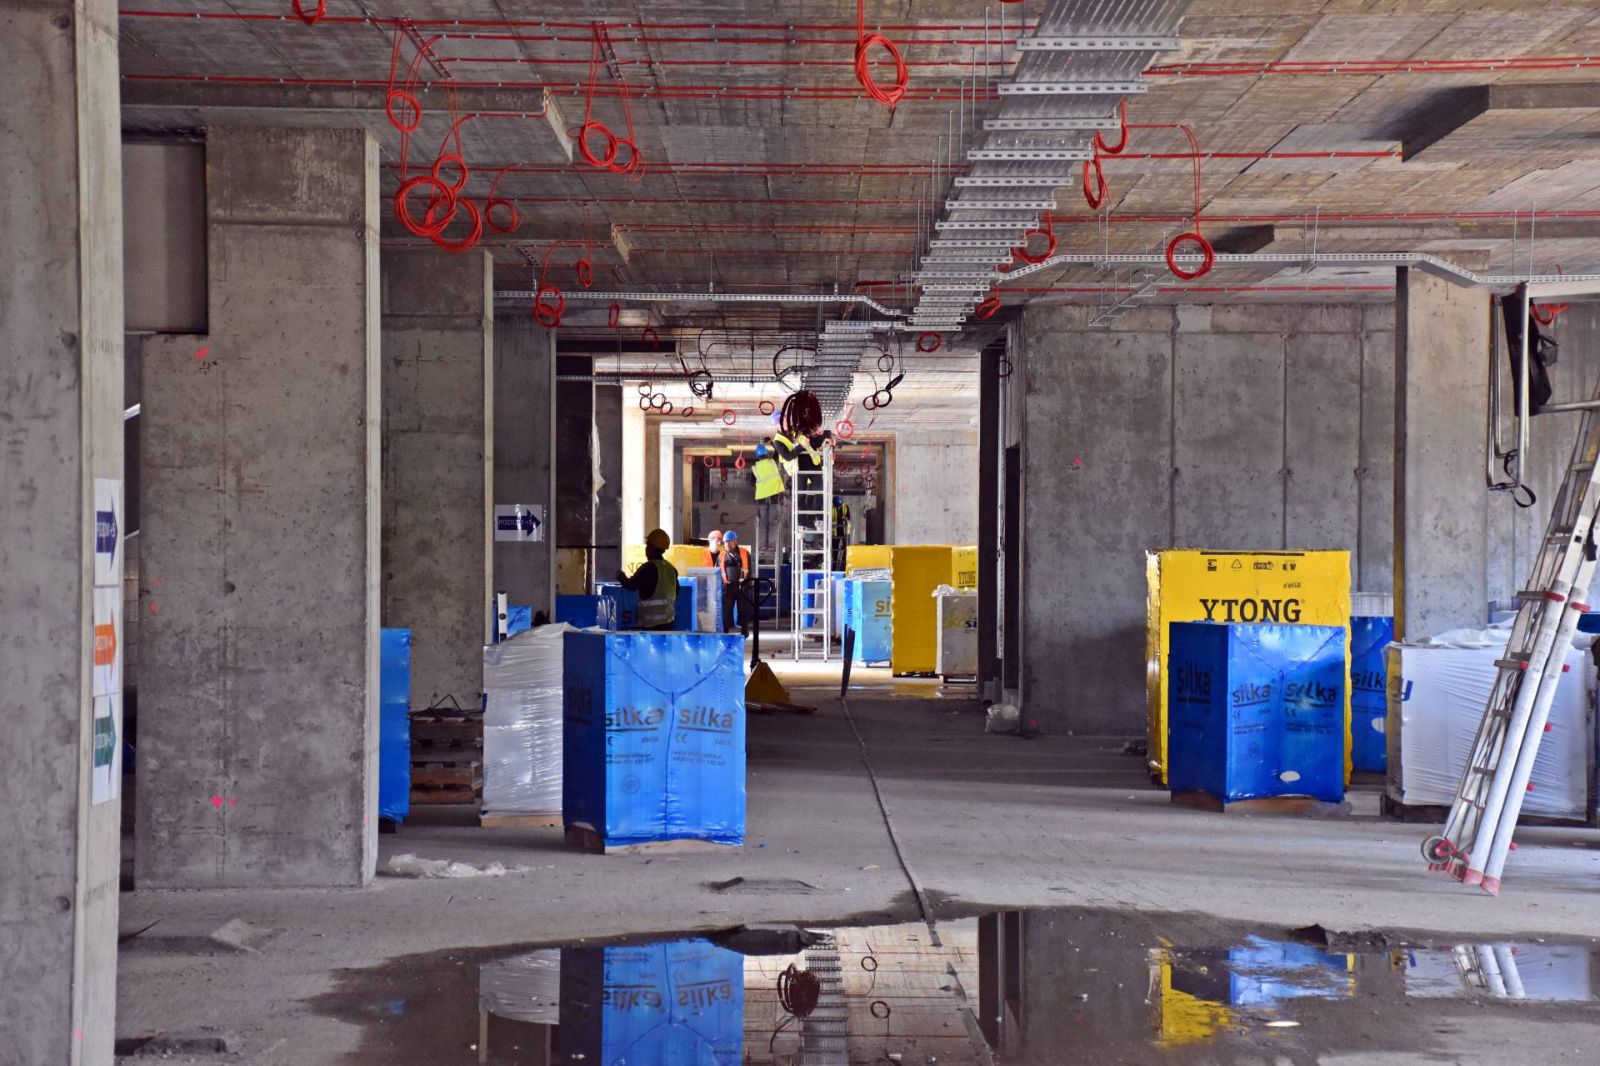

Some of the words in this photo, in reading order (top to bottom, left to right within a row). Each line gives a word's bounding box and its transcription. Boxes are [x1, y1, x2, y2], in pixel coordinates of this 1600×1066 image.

[1199, 598, 1302, 623] YTONG
[1352, 669, 1386, 689] silk
[1232, 683, 1271, 703] silka
[1285, 680, 1337, 702] silka
[679, 706, 733, 729] silka
